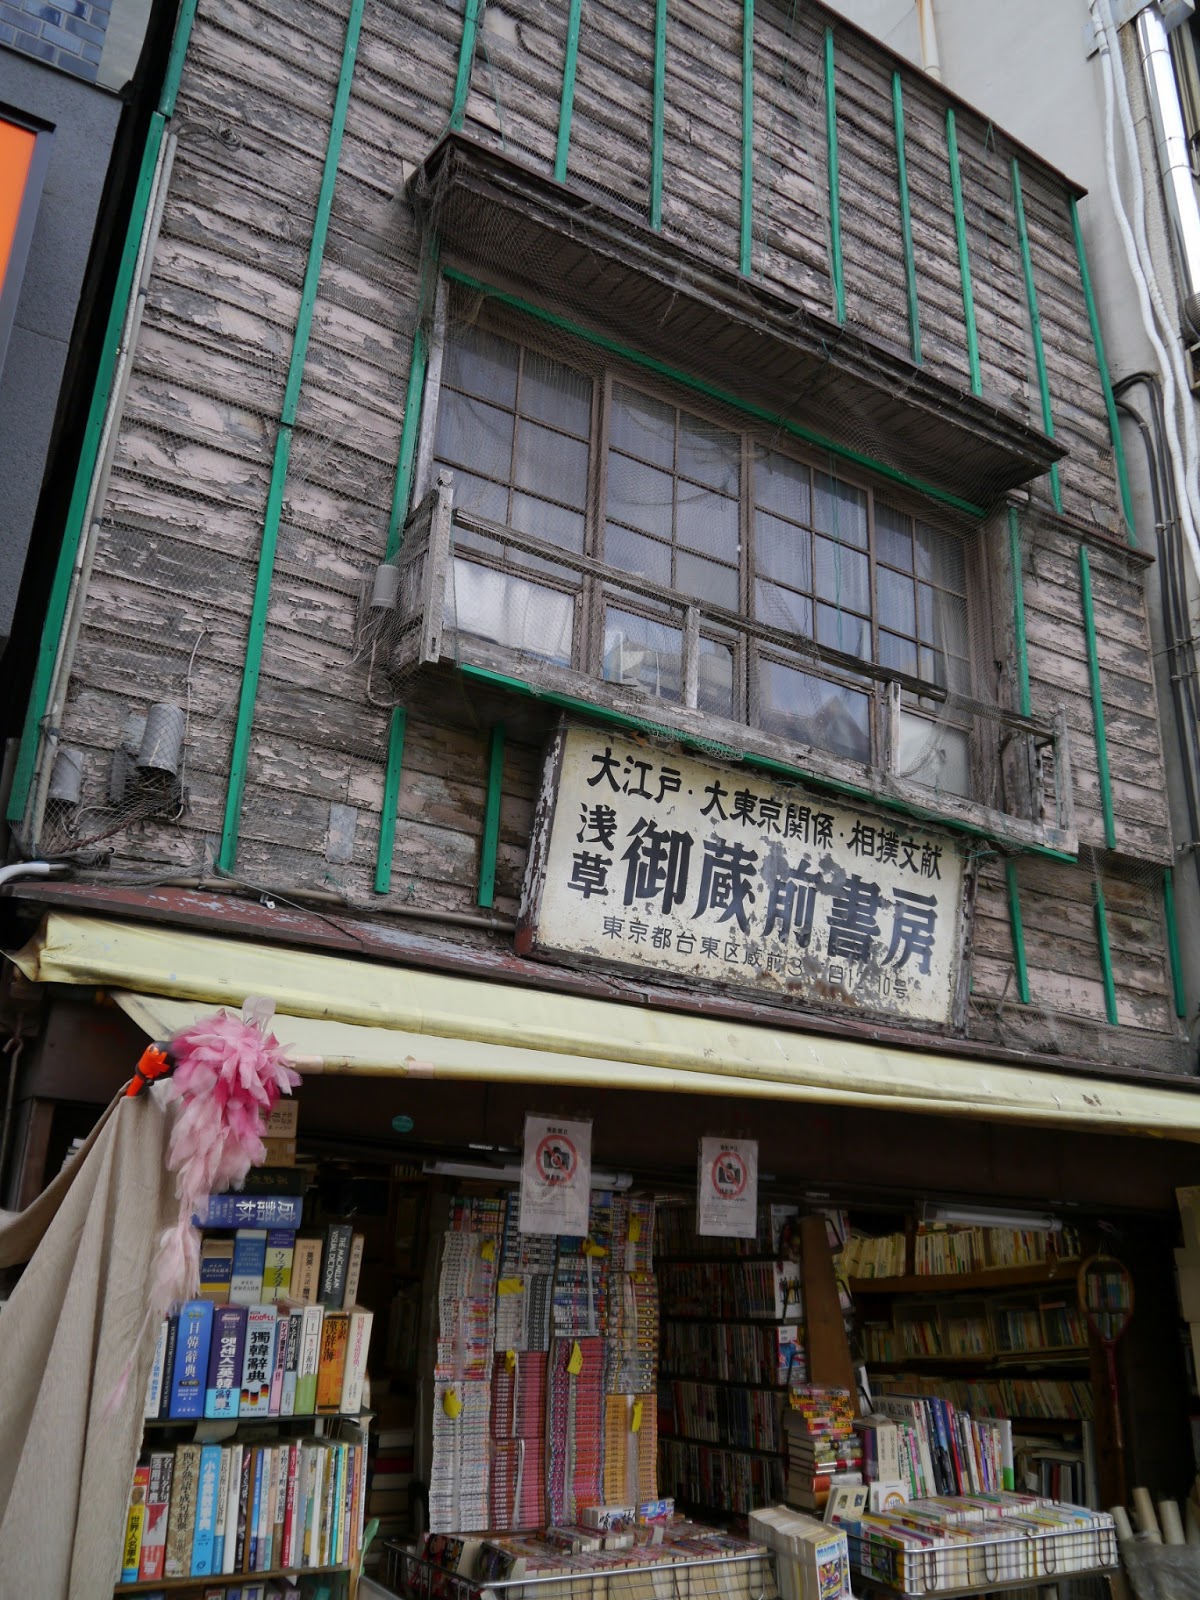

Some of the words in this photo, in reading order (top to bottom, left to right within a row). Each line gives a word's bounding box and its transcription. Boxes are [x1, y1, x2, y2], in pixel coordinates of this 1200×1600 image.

[566, 802, 618, 899] 浅草
[619, 816, 938, 975] 御蔵前書房
[235, 1200, 296, 1222] 成語林
